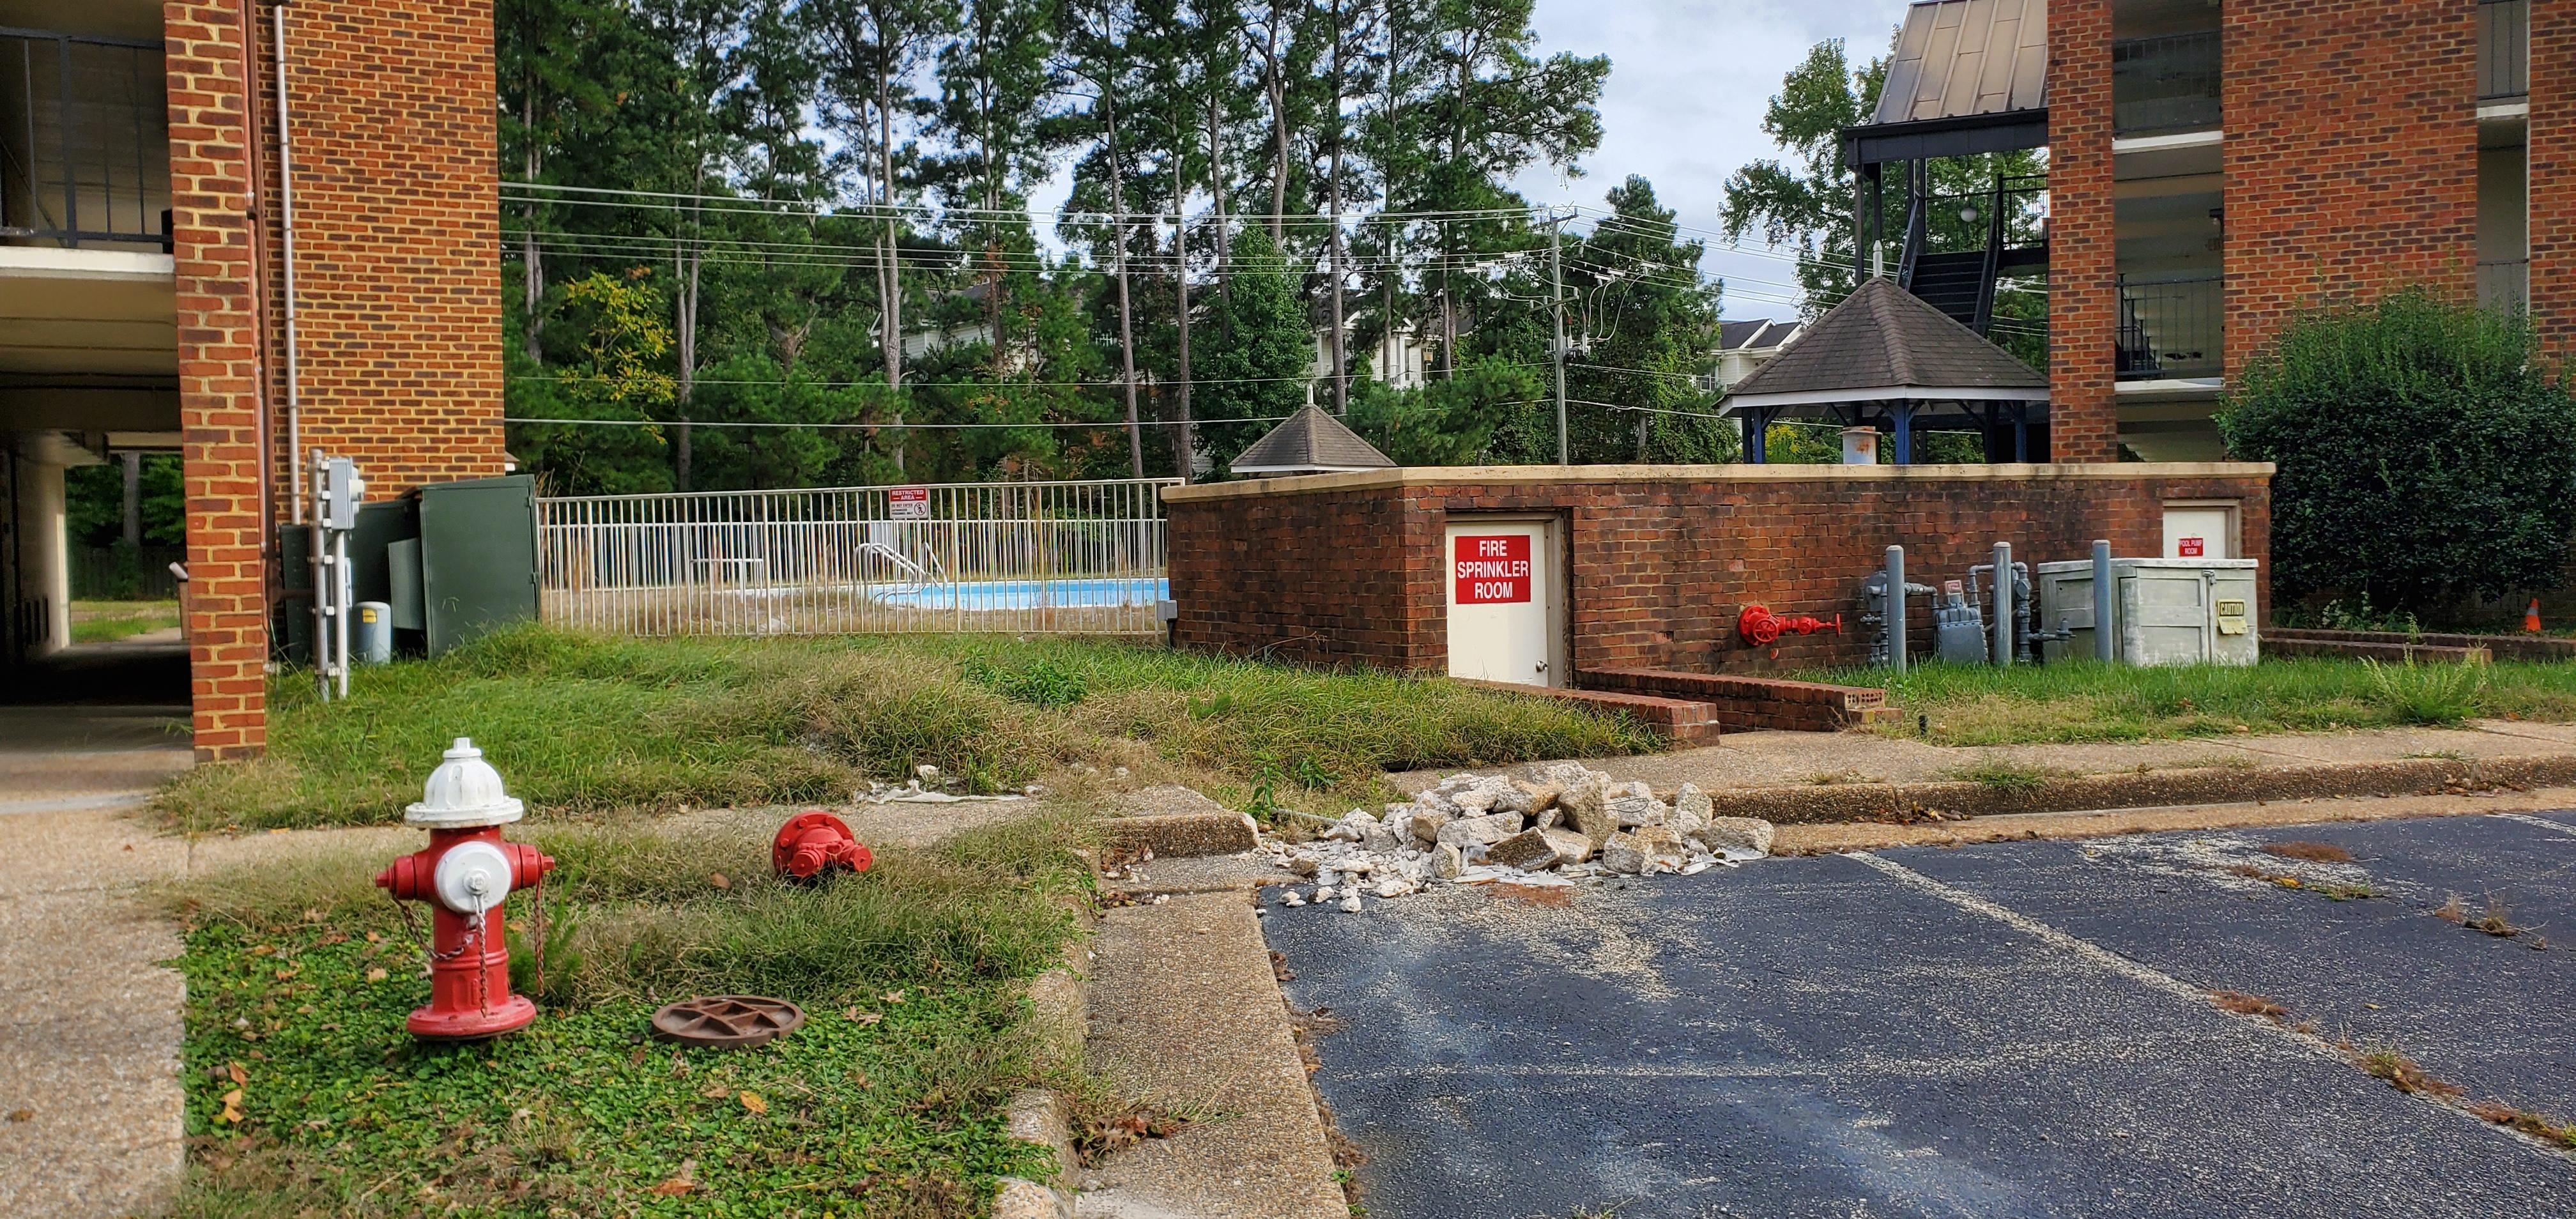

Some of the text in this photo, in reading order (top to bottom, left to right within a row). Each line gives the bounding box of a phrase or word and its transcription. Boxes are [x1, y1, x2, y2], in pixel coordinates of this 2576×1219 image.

[1479, 540, 1508, 557] FIRE
[1457, 561, 1529, 578] SPRINKLER
[1475, 581, 1513, 599] ROOM
[2220, 603, 2243, 615] CAUTION
